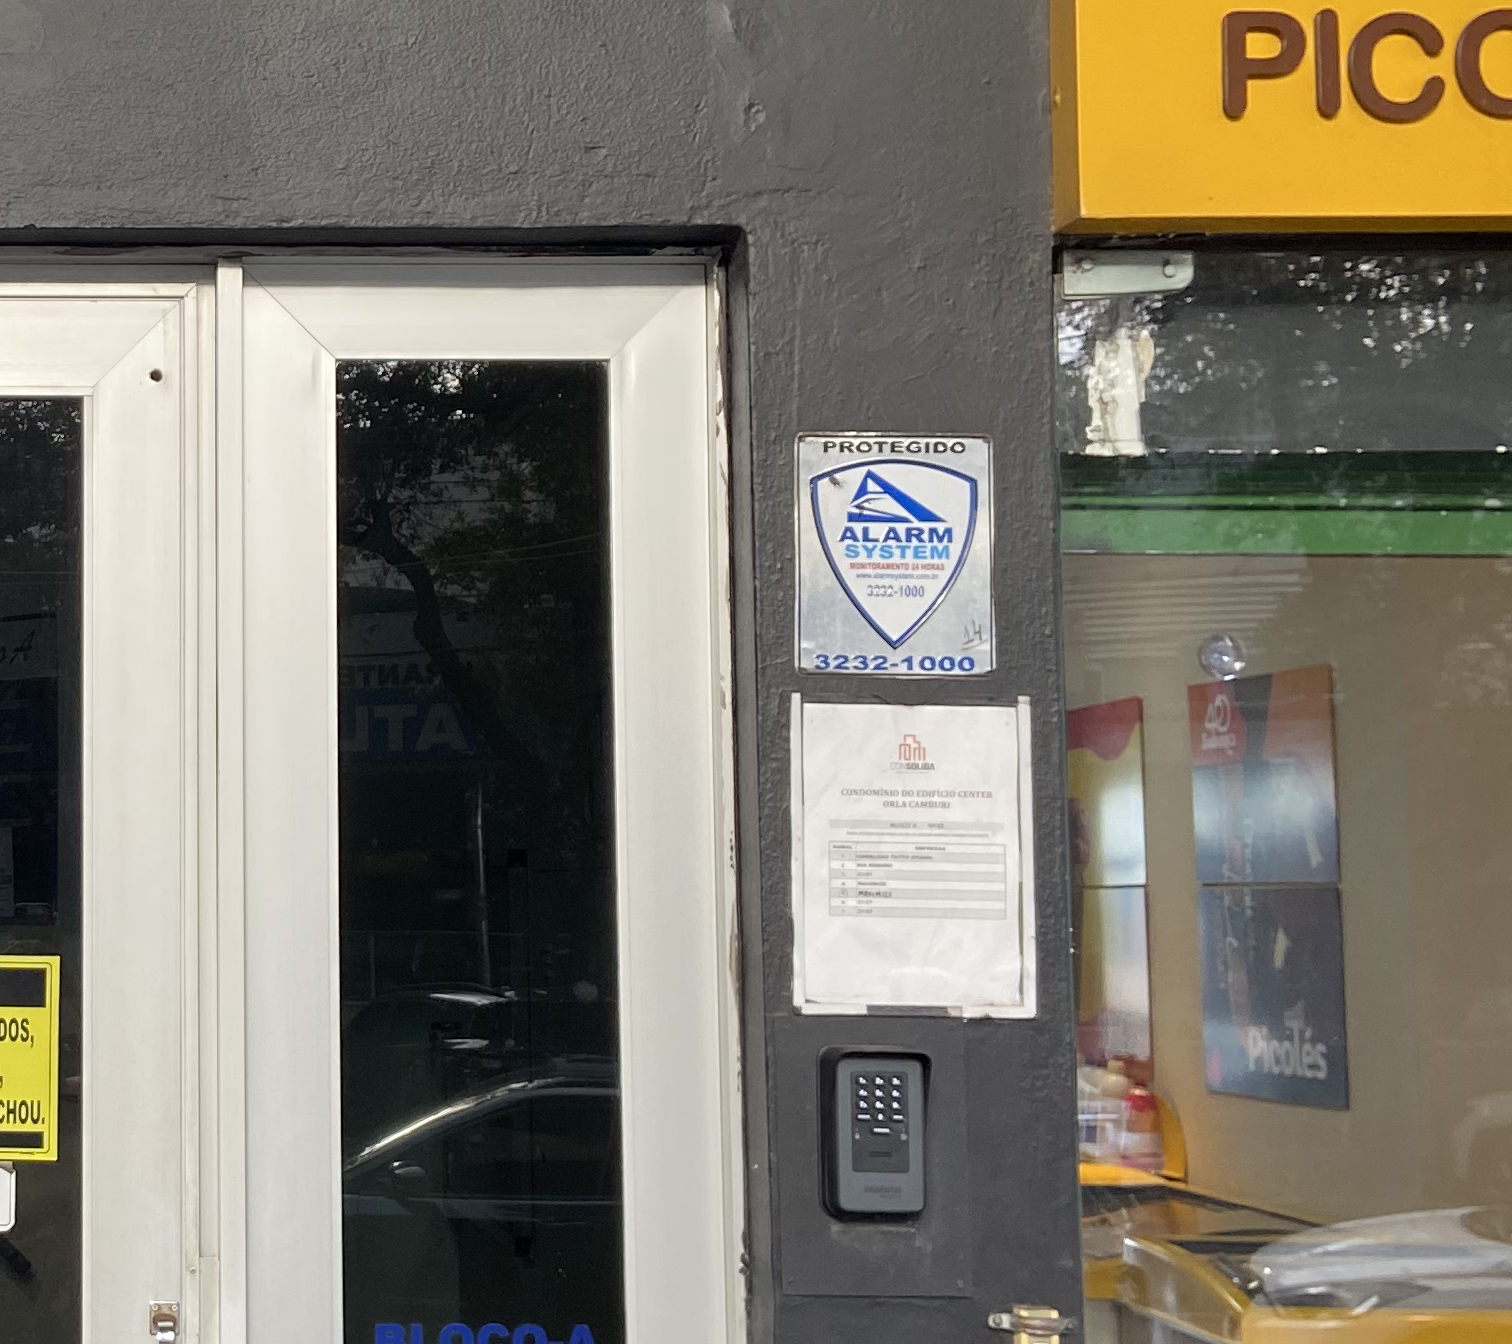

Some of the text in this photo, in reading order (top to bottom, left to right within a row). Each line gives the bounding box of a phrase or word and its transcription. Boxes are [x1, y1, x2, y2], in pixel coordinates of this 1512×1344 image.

[823, 440, 966, 454] PROTEGIDO
[838, 526, 953, 544] ALARM
[845, 544, 950, 560] SYSTEM
[866, 585, 925, 598] 3232-1000
[814, 654, 975, 672] 3232-1000
[957, 790, 993, 798] CENTER
[883, 800, 907, 808] ORLA
